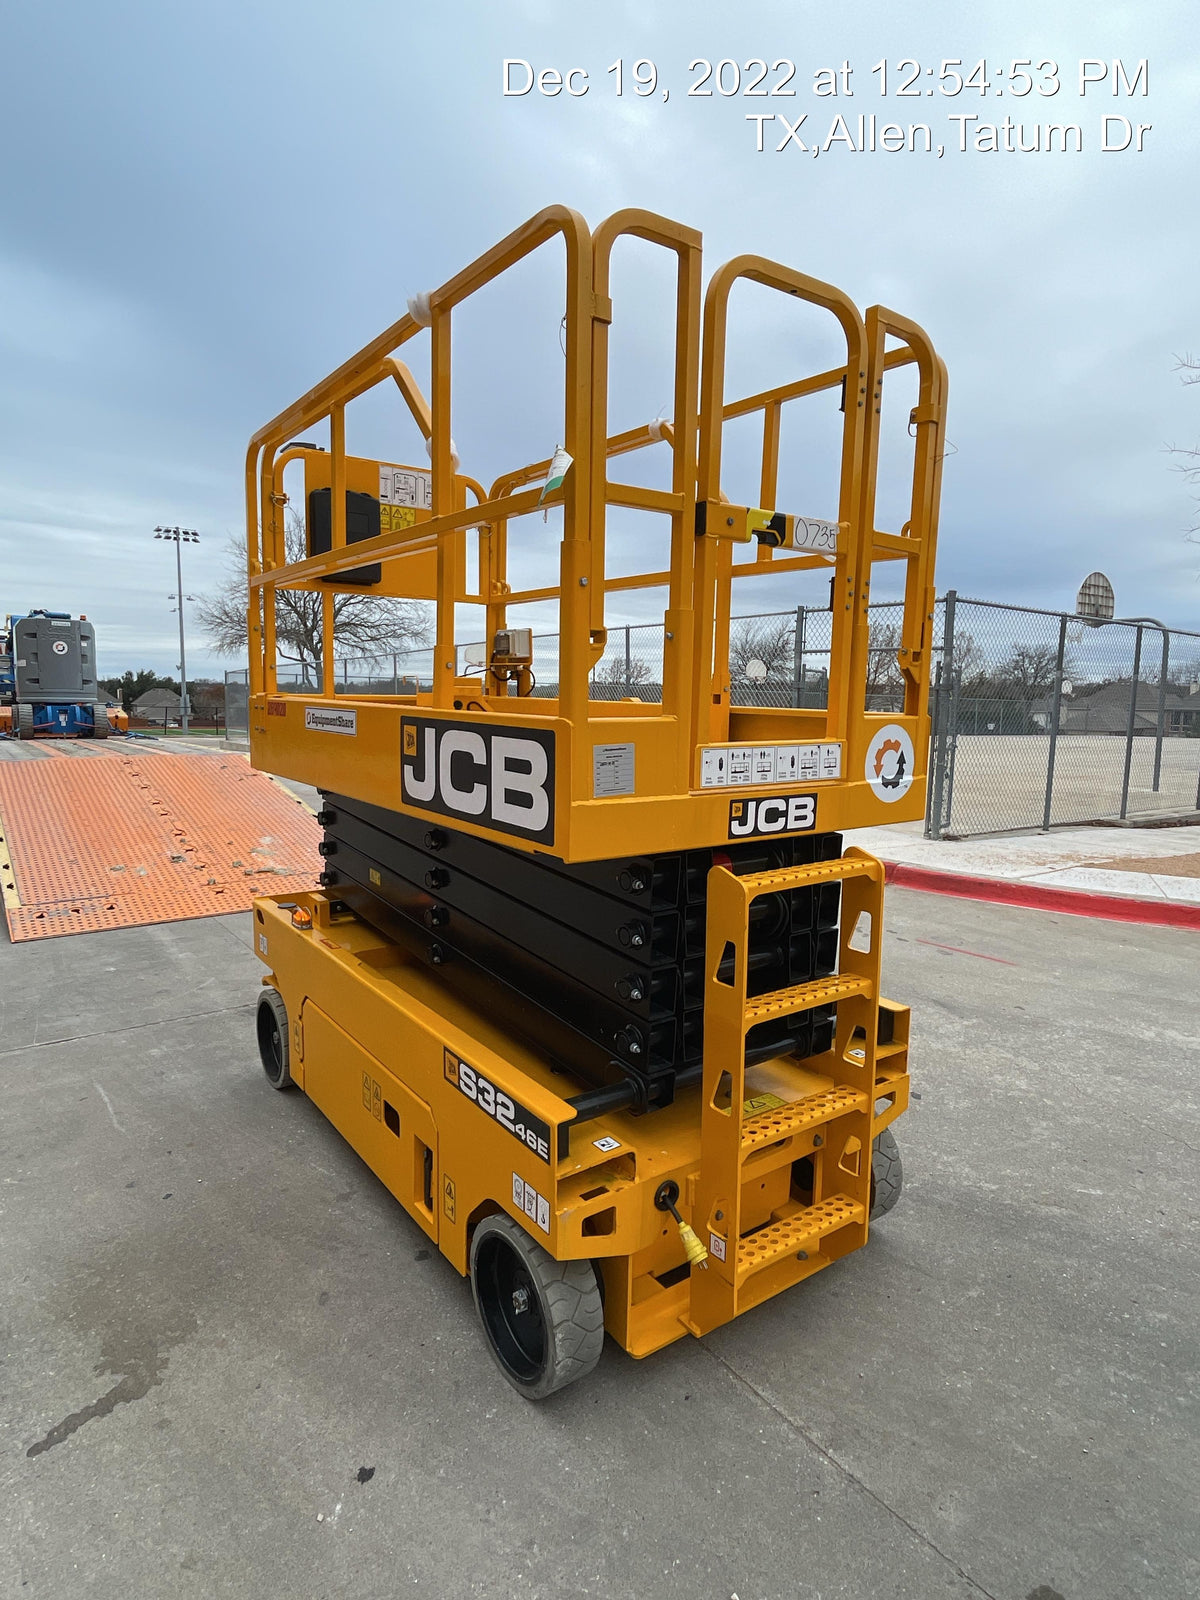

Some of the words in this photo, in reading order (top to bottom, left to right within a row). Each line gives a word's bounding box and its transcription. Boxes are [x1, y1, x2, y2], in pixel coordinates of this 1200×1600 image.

[795, 518, 837, 550] 0735
[311, 713, 354, 729] EquipmentShare
[403, 727, 550, 832] JCB
[730, 796, 815, 836] JCB
